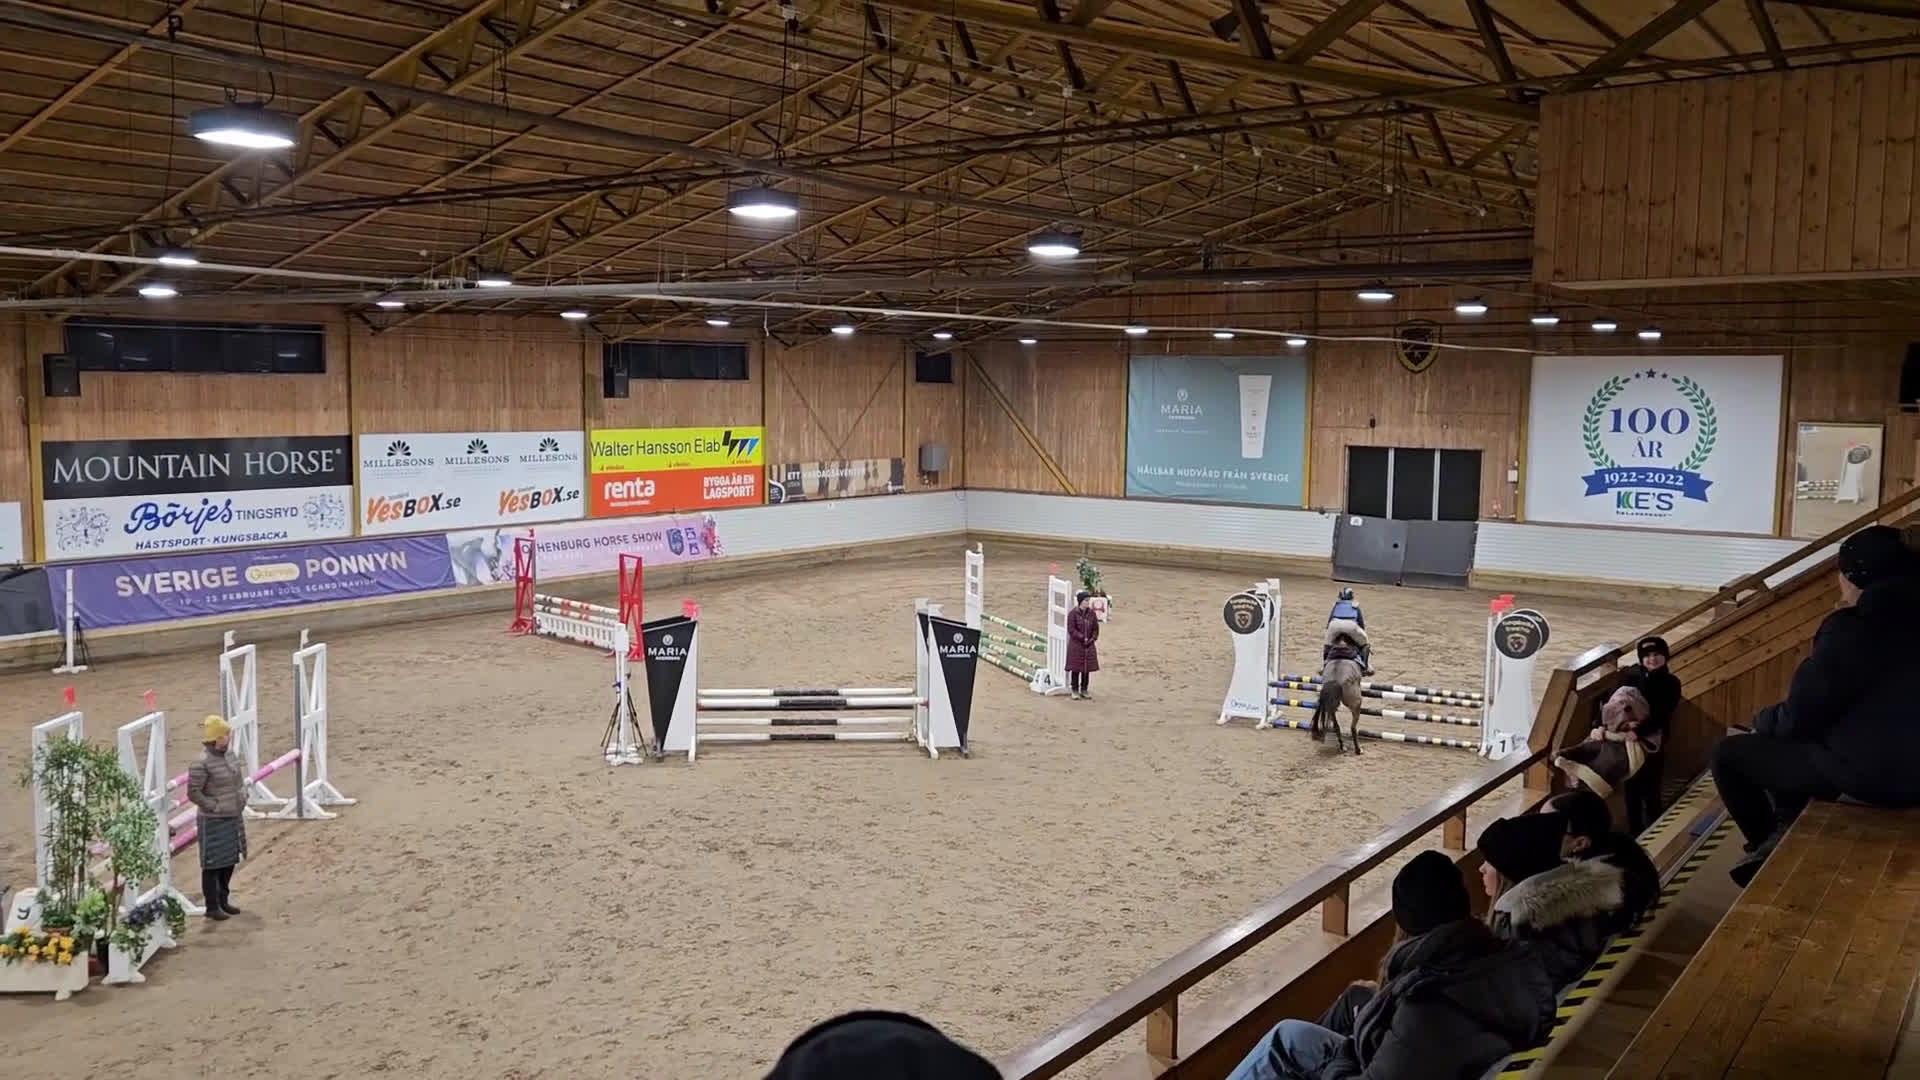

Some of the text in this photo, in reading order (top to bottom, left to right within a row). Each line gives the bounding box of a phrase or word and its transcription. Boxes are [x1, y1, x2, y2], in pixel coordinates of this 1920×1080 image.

[1160, 404, 1203, 415] MARIA
[1608, 408, 1690, 435] 100
[591, 438, 720, 457] Walter Hansson Elab
[1632, 436, 1663, 458] ÅR
[364, 458, 434, 468] MILLESONS
[445, 455, 510, 465] MILLESONS
[519, 453, 578, 463] MILLESONS
[53, 453, 230, 484] MOUNTAIN
[1137, 463, 1289, 482] HÅLLBAR HUDVÅRD FRÅN SVERIGE
[704, 476, 730, 488] BYGGA
[743, 474, 754, 484] EN
[1604, 472, 1684, 486] 1922-2022
[604, 477, 656, 500] renta
[704, 484, 754, 499] LAGSPORT!
[124, 498, 298, 534] Börjes TINGSRYD
[213, 531, 288, 543] KUNGSBACKA
[594, 534, 629, 547] HORSE
[632, 531, 662, 544] SHOW
[115, 566, 239, 597] SVERIGE
[306, 551, 407, 578] PONNYN
[222, 588, 274, 601] FEBRUARI
[648, 647, 687, 656] MARIA
[940, 644, 976, 654] MARIA
[1043, 674, 1051, 685] 4
[1499, 739, 1506, 753] 1
